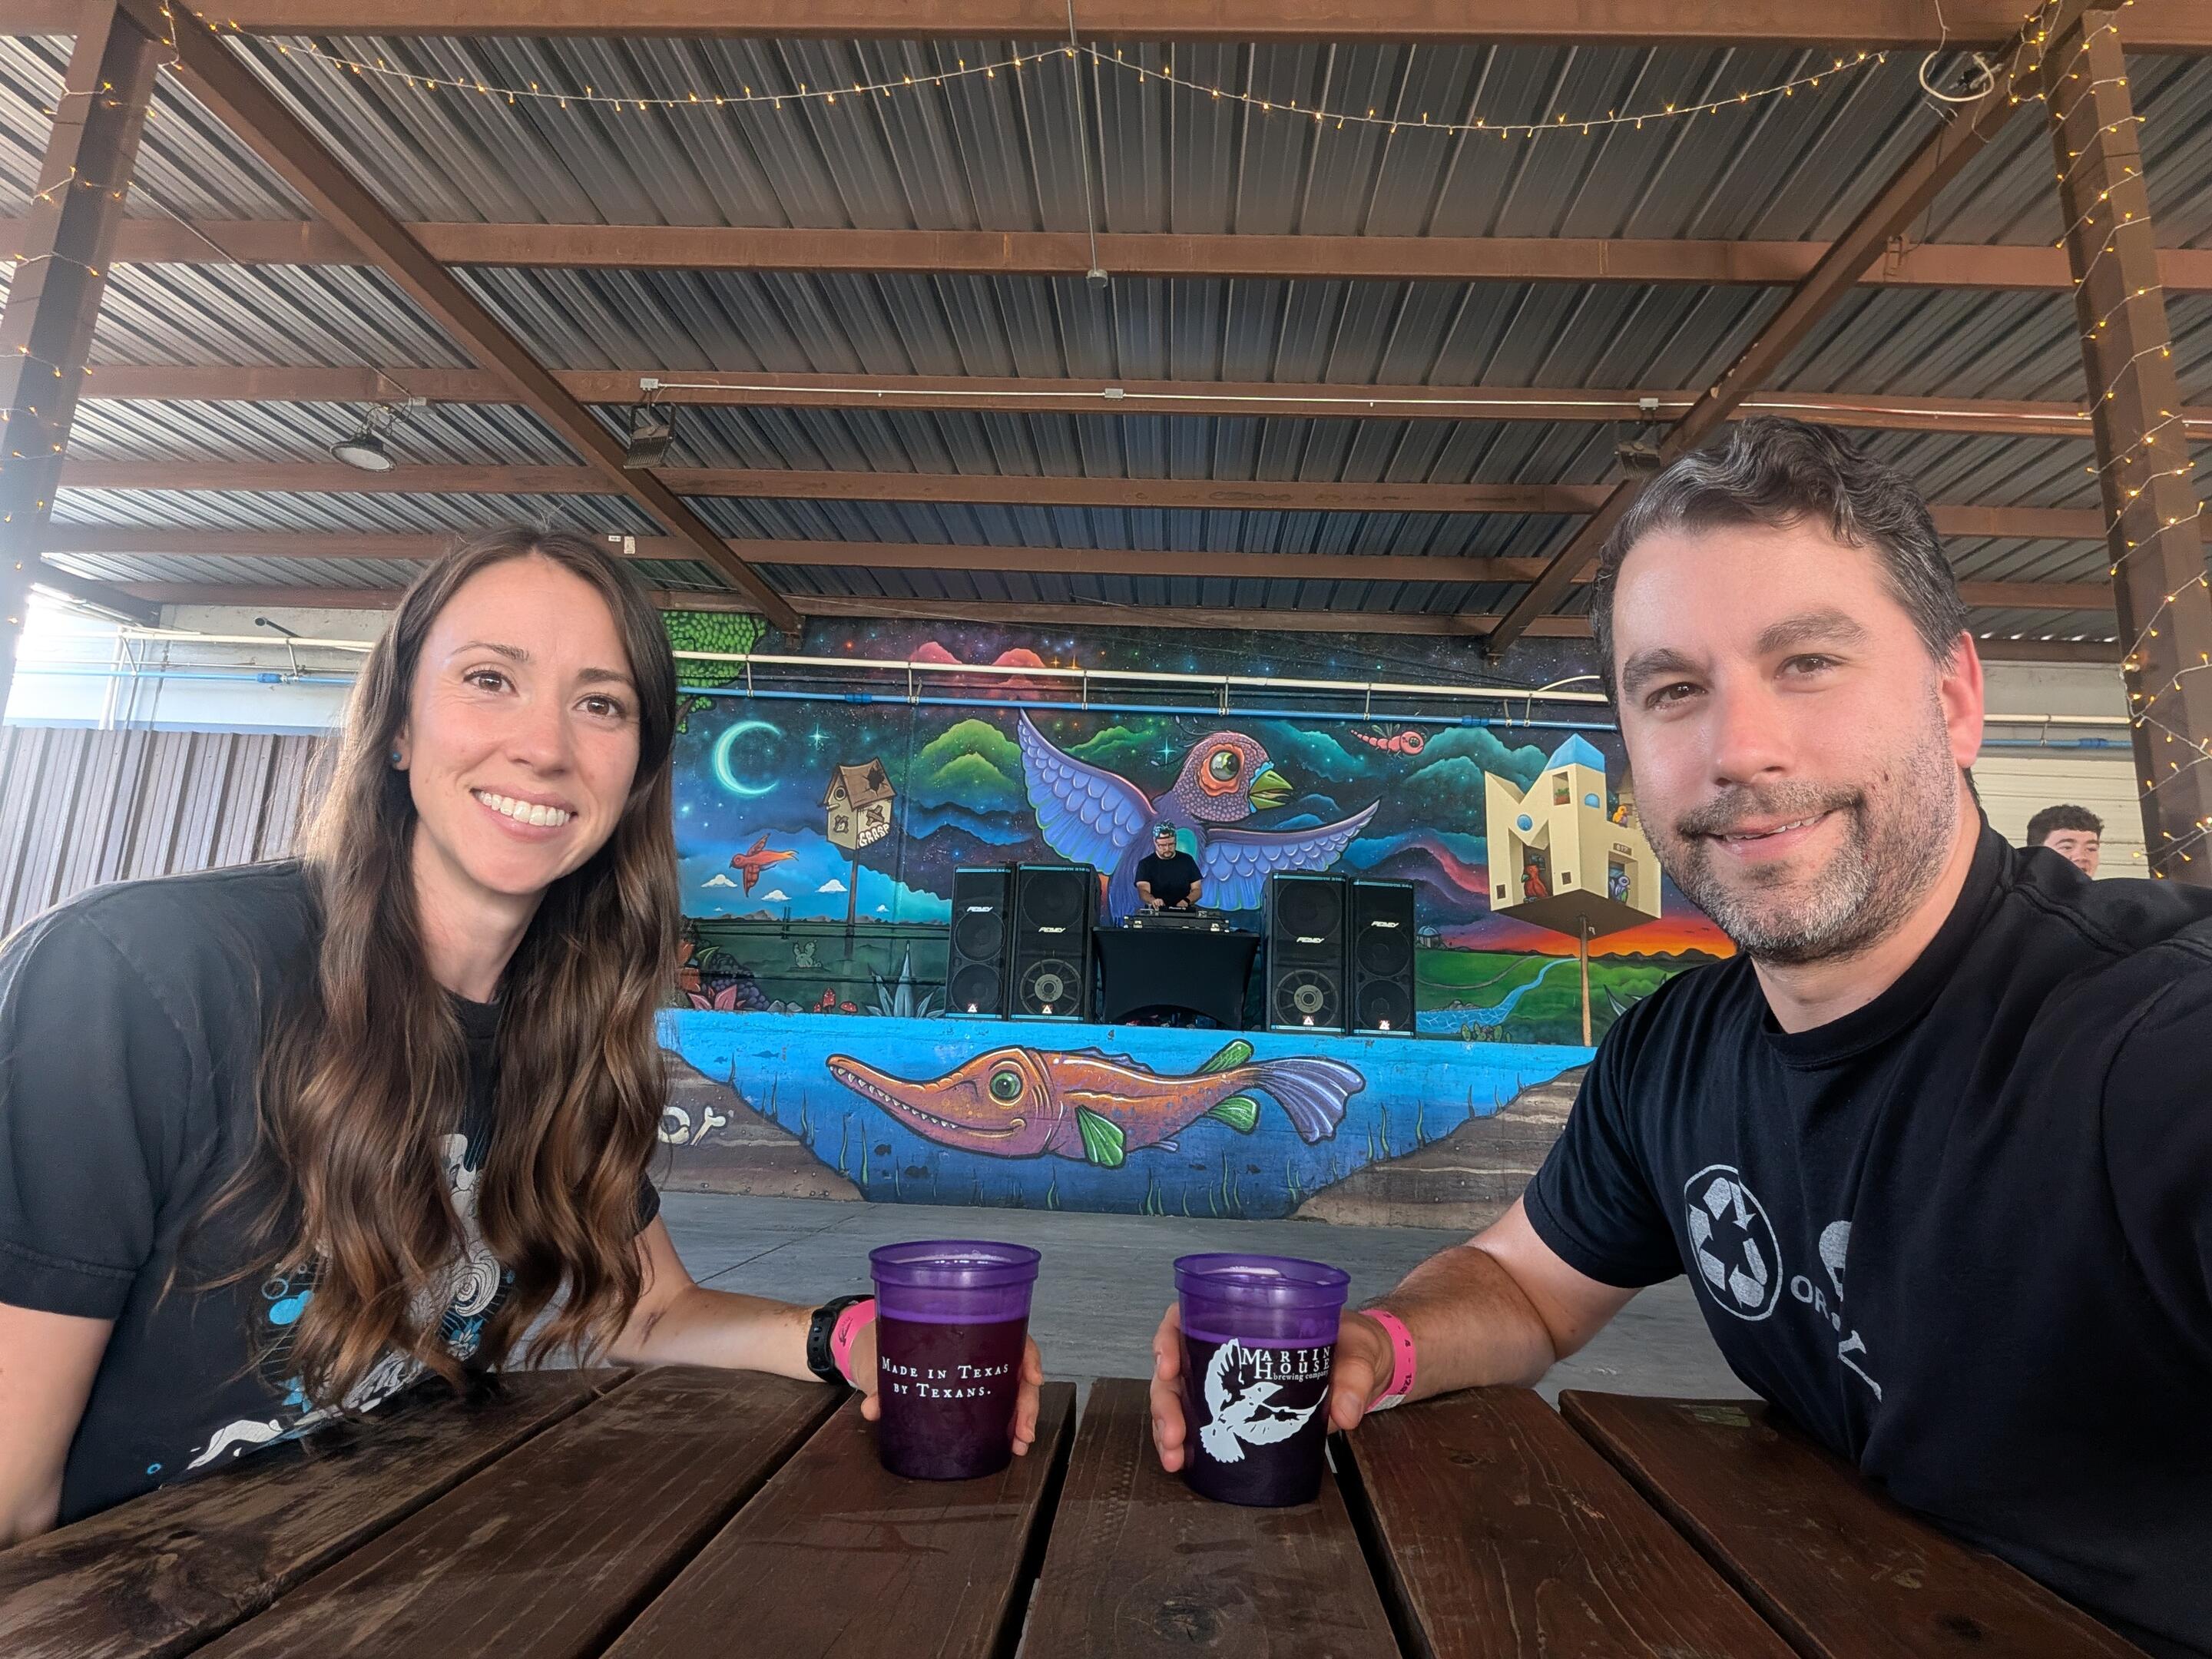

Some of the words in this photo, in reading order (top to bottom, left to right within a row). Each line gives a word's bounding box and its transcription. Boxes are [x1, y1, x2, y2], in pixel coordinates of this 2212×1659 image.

[859, 823, 889, 847] GRASP
[1241, 1346, 1330, 1366] MARTIN
[882, 1356, 918, 1376] MADE
[927, 1369, 947, 1379] IN
[957, 1364, 1008, 1379] TEXAS
[1253, 1359, 1330, 1380] HOUSE
[1273, 1373, 1303, 1382] brewing
[1305, 1369, 1329, 1380] company
[916, 1383, 991, 1398] TEXANS.
